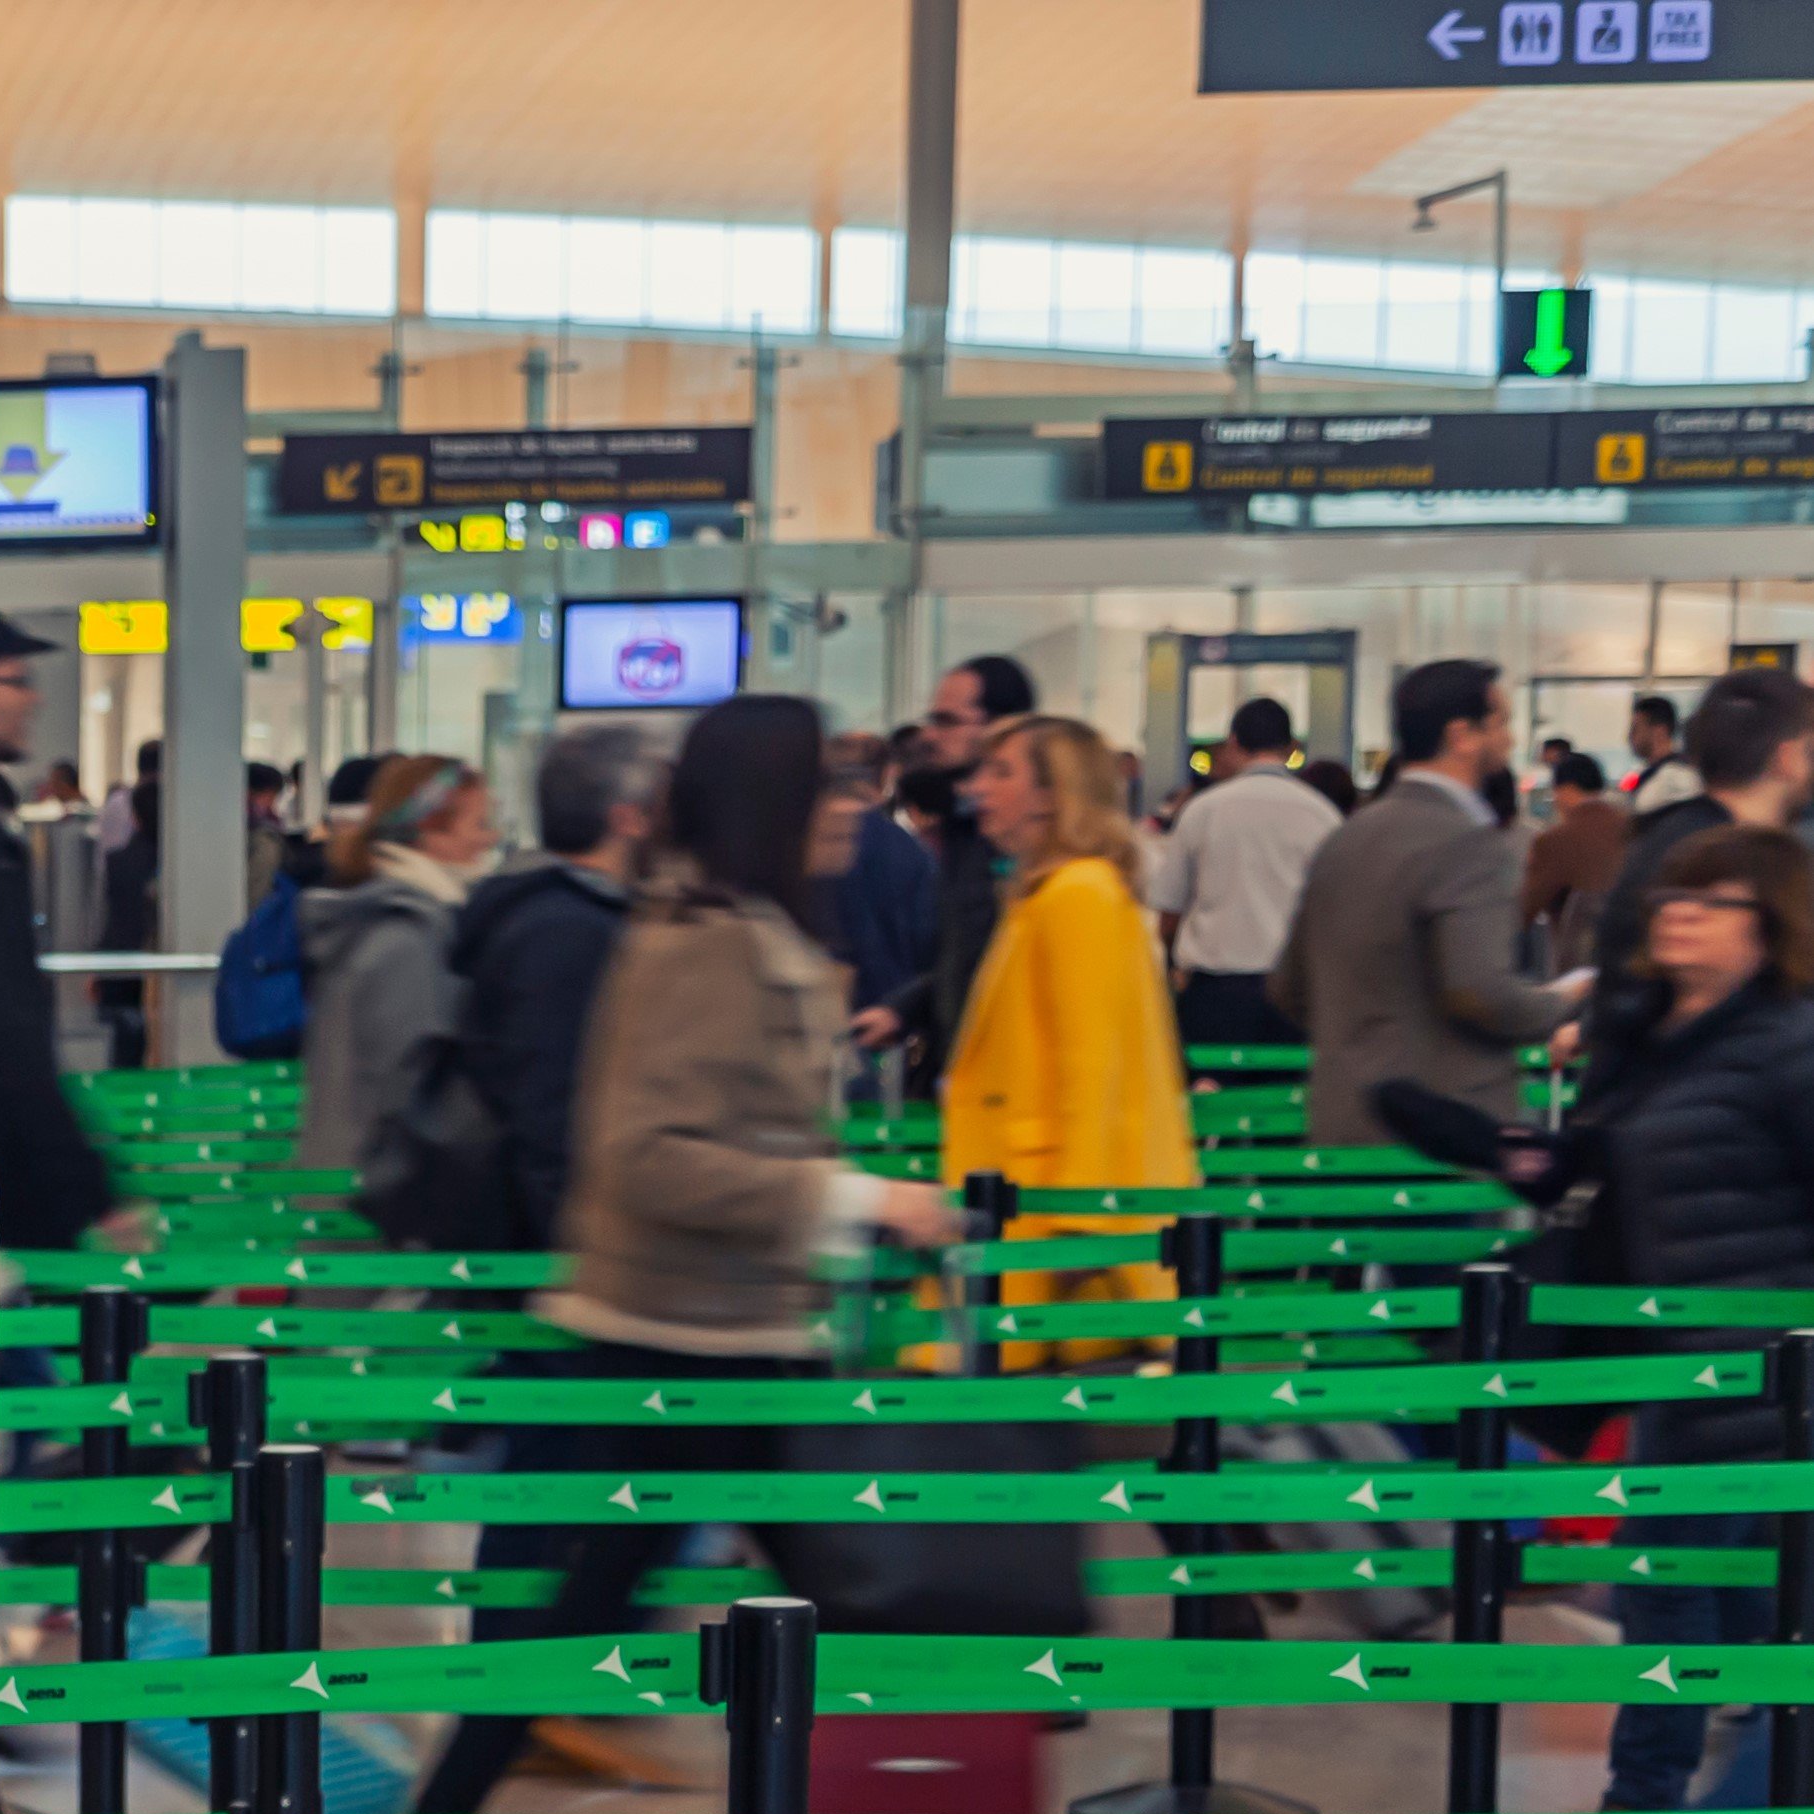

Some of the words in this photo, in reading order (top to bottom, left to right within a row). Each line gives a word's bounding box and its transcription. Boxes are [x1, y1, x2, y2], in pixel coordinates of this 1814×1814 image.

[629, 1657, 671, 1670] aena
[1061, 1661, 1104, 1674] aena
[327, 1672, 369, 1686] aena
[1368, 1666, 1411, 1679] aena
[1677, 1668, 1721, 1680] aena
[25, 1687, 66, 1701] aena
